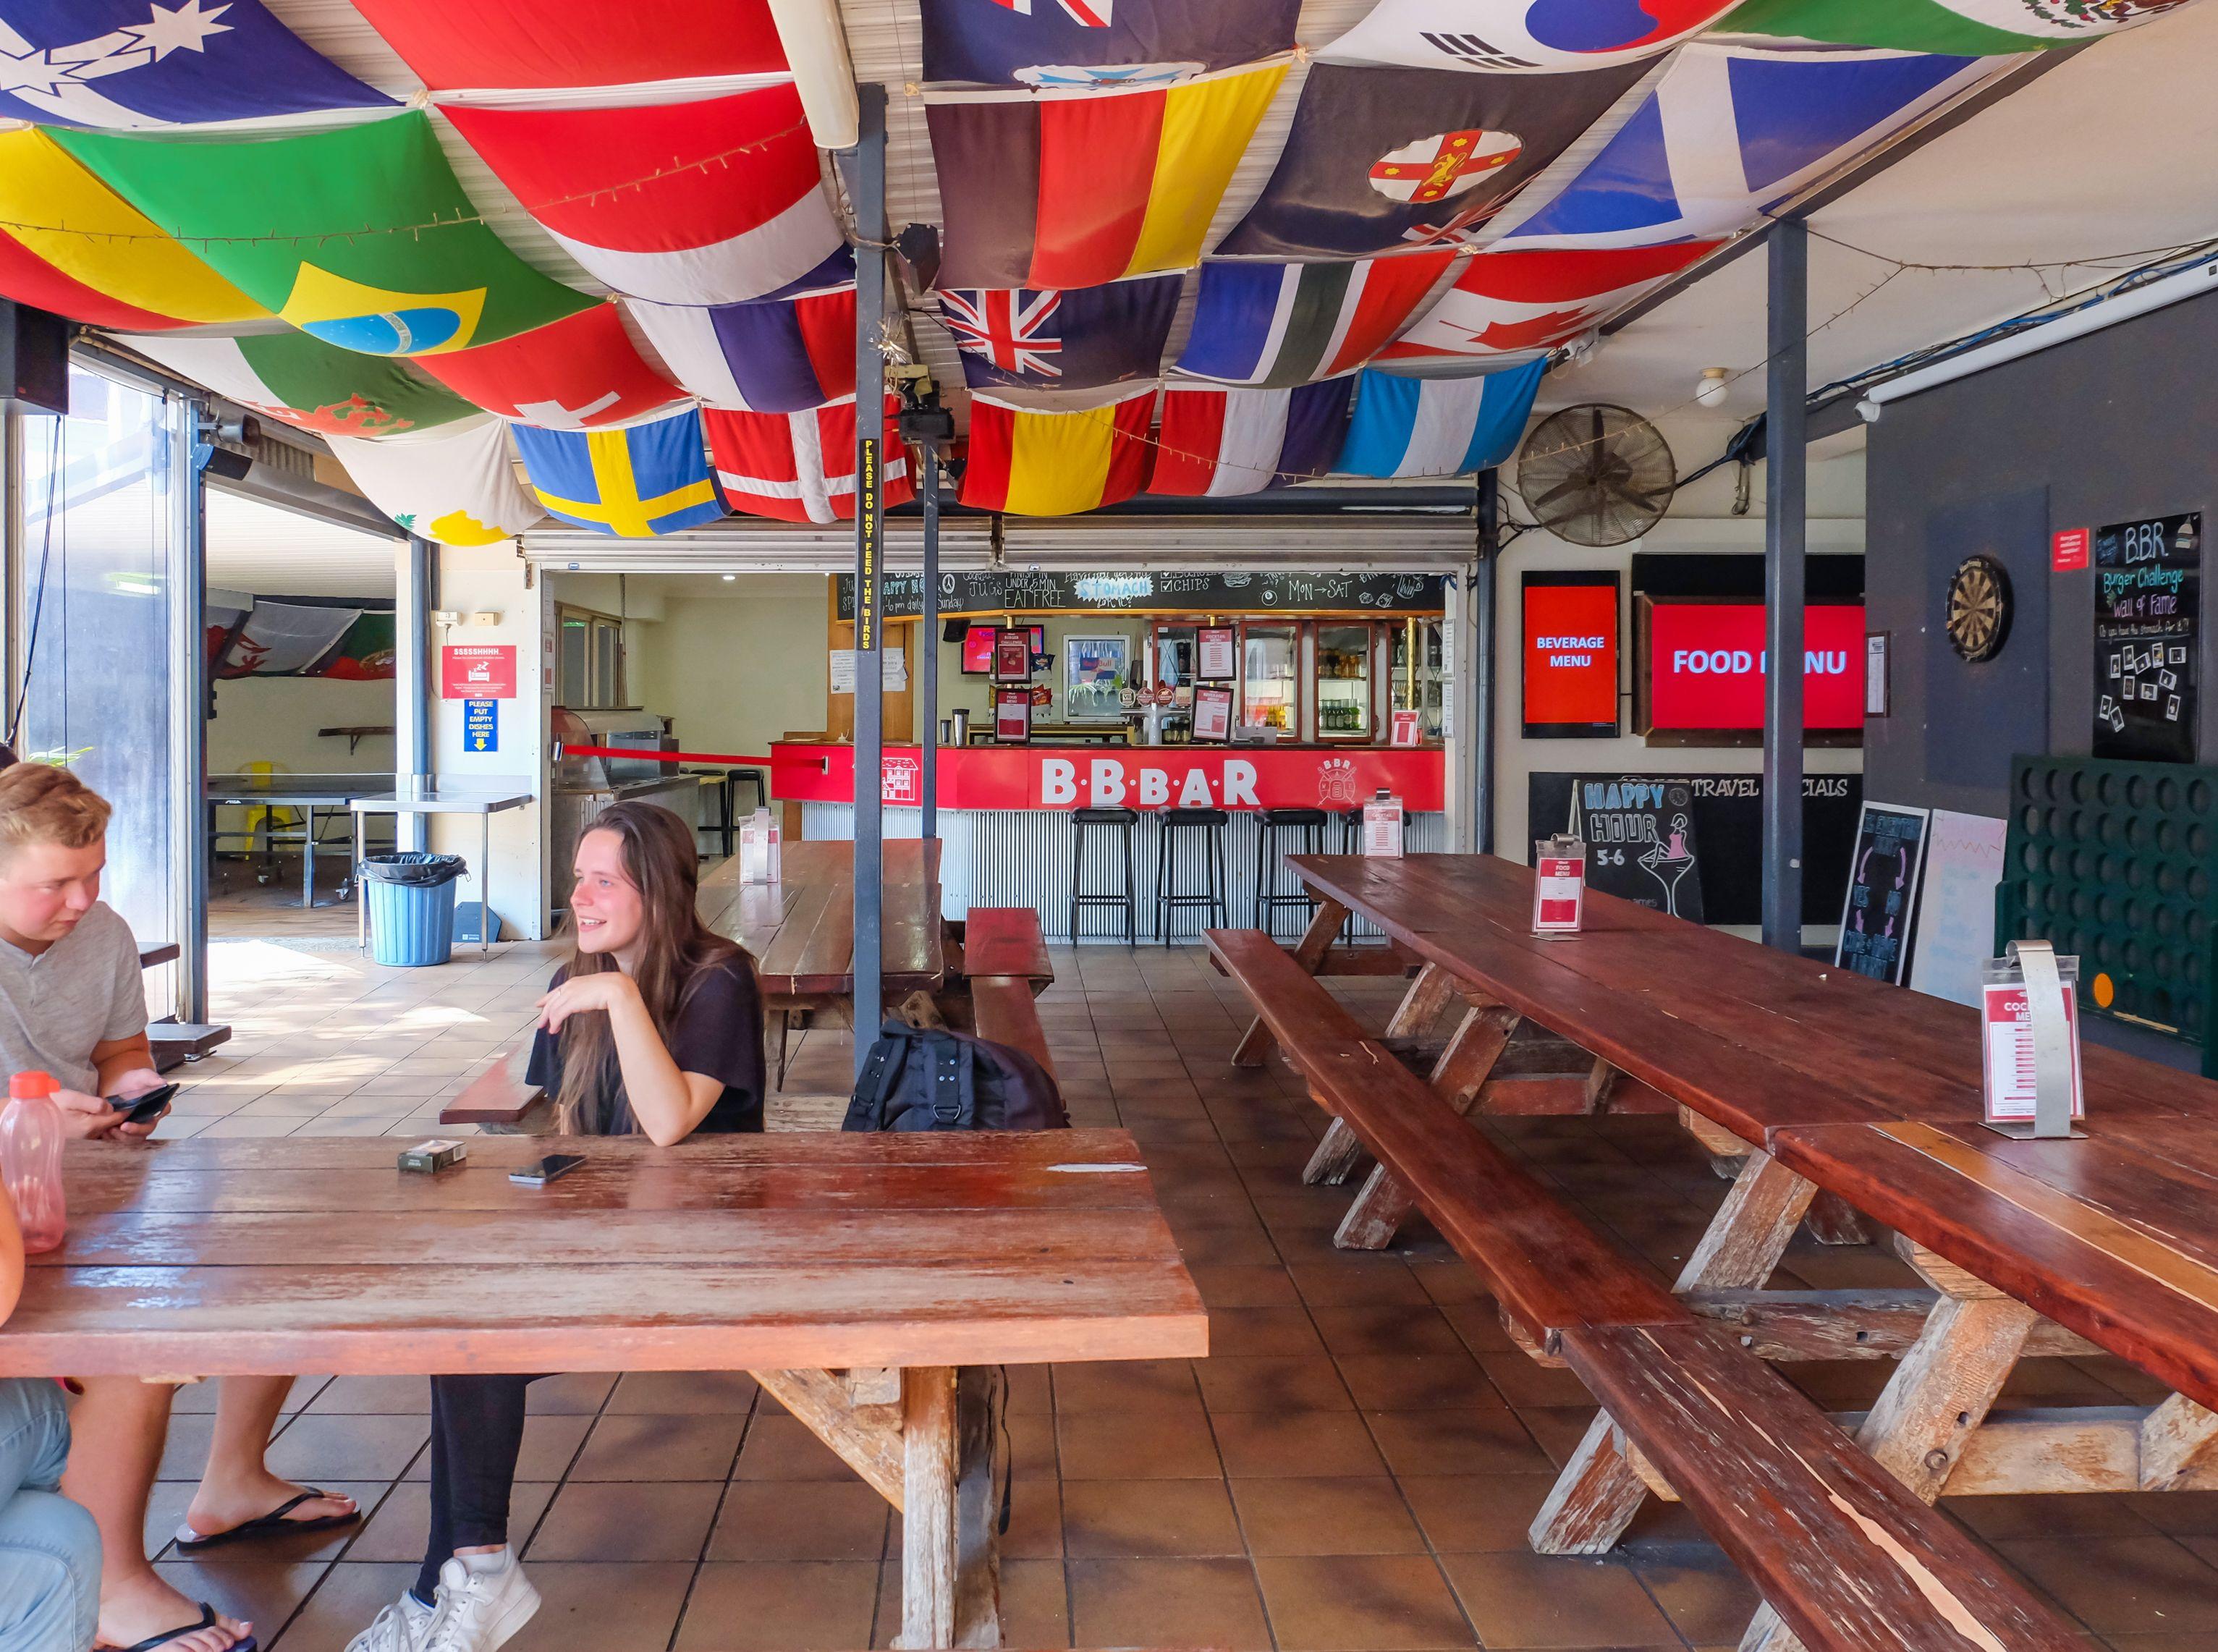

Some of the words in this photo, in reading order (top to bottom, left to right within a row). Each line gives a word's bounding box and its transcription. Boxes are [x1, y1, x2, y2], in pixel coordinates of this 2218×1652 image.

[865, 440, 873, 488] PLEASE
[865, 493, 873, 509] DO
[865, 514, 873, 538] NOT
[883, 580, 907, 596] APPY
[1005, 577, 1028, 589] UNDER
[1039, 579, 1056, 590] MIN
[1173, 577, 1211, 592] CHIPS
[1326, 579, 1353, 598] SAT
[2104, 572, 2136, 595] Burger
[2137, 563, 2184, 593] Challenge
[864, 580, 873, 604] THE
[969, 581, 1003, 597] JUGS
[1004, 589, 1030, 608] EAT
[1033, 589, 1066, 608] FREE
[1080, 580, 1148, 598] STOMACH
[894, 602, 905, 614] pm
[907, 596, 925, 614] daily
[937, 593, 965, 613] Sunday
[2136, 595, 2146, 617] of
[2150, 594, 2177, 616] Fame
[863, 609, 871, 649] BIRDS
[1536, 637, 1604, 649] BEVERAGE
[1549, 655, 1591, 667] MENU
[1673, 650, 1752, 674] FOOD
[1584, 782, 1664, 810] HAPPY
[1691, 778, 1759, 797] TRAVEL
[1590, 813, 1660, 843] HOUR
[1596, 849, 1625, 866] 5-6
